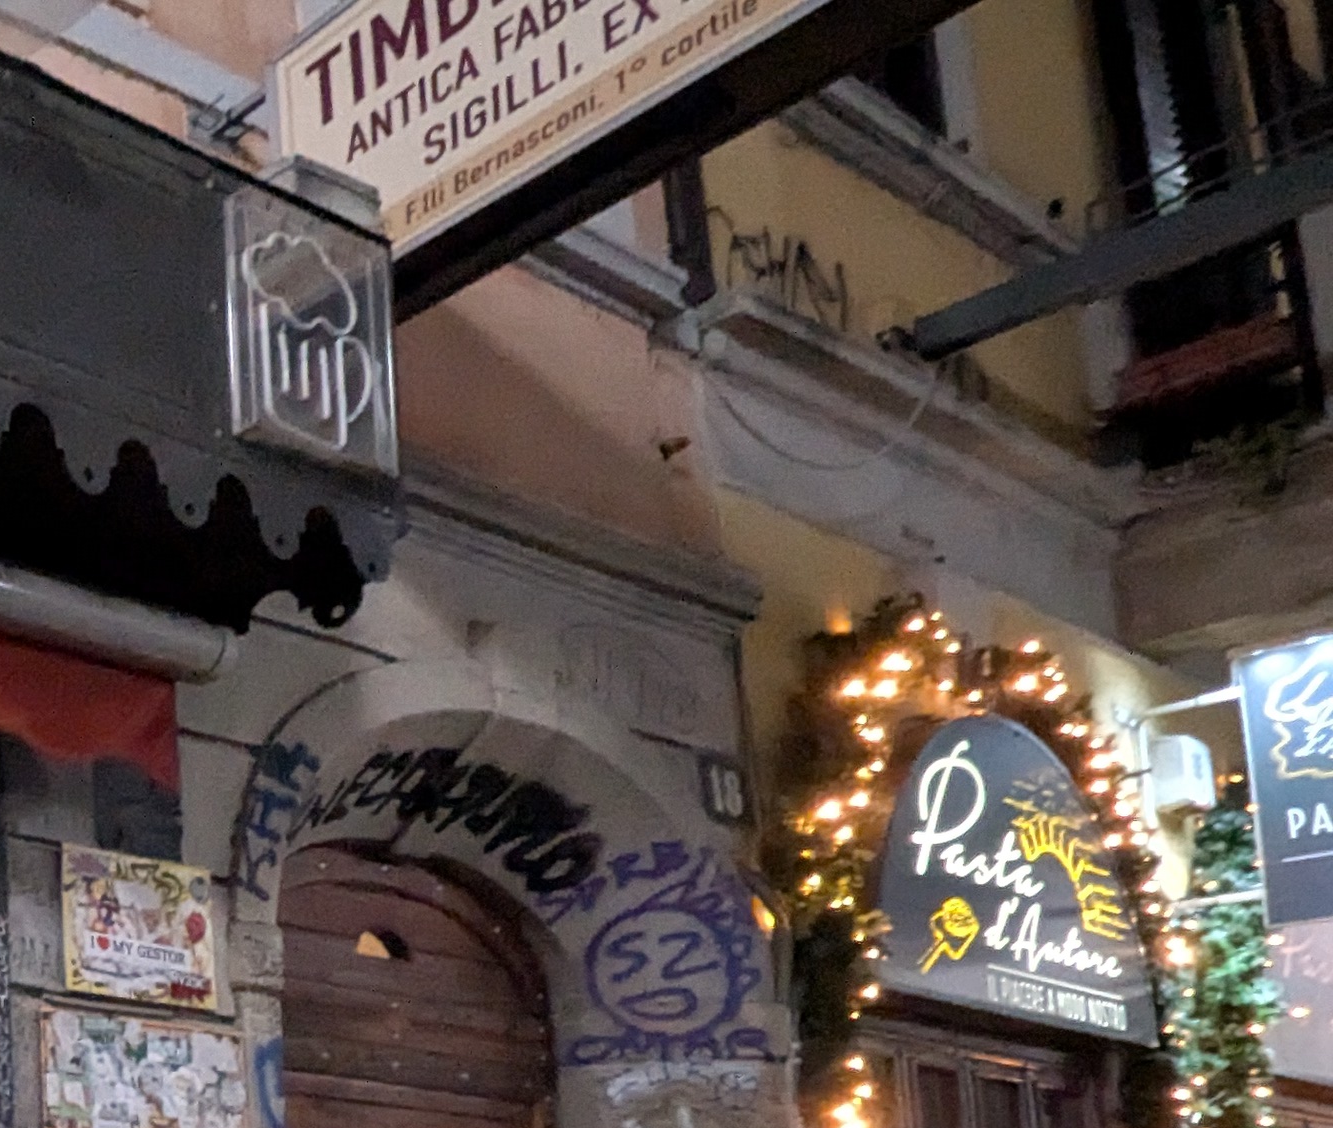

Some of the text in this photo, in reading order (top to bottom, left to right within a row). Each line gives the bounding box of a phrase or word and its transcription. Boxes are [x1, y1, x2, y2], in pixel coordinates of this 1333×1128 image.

[346, 47, 480, 163] ANTICA
[423, 40, 582, 165] SIGILLI.
[454, 88, 603, 194] Bernasconi.
[661, 0, 757, 66] cortile
[911, 740, 1044, 897] Pasta
[113, 940, 133, 955] MY
